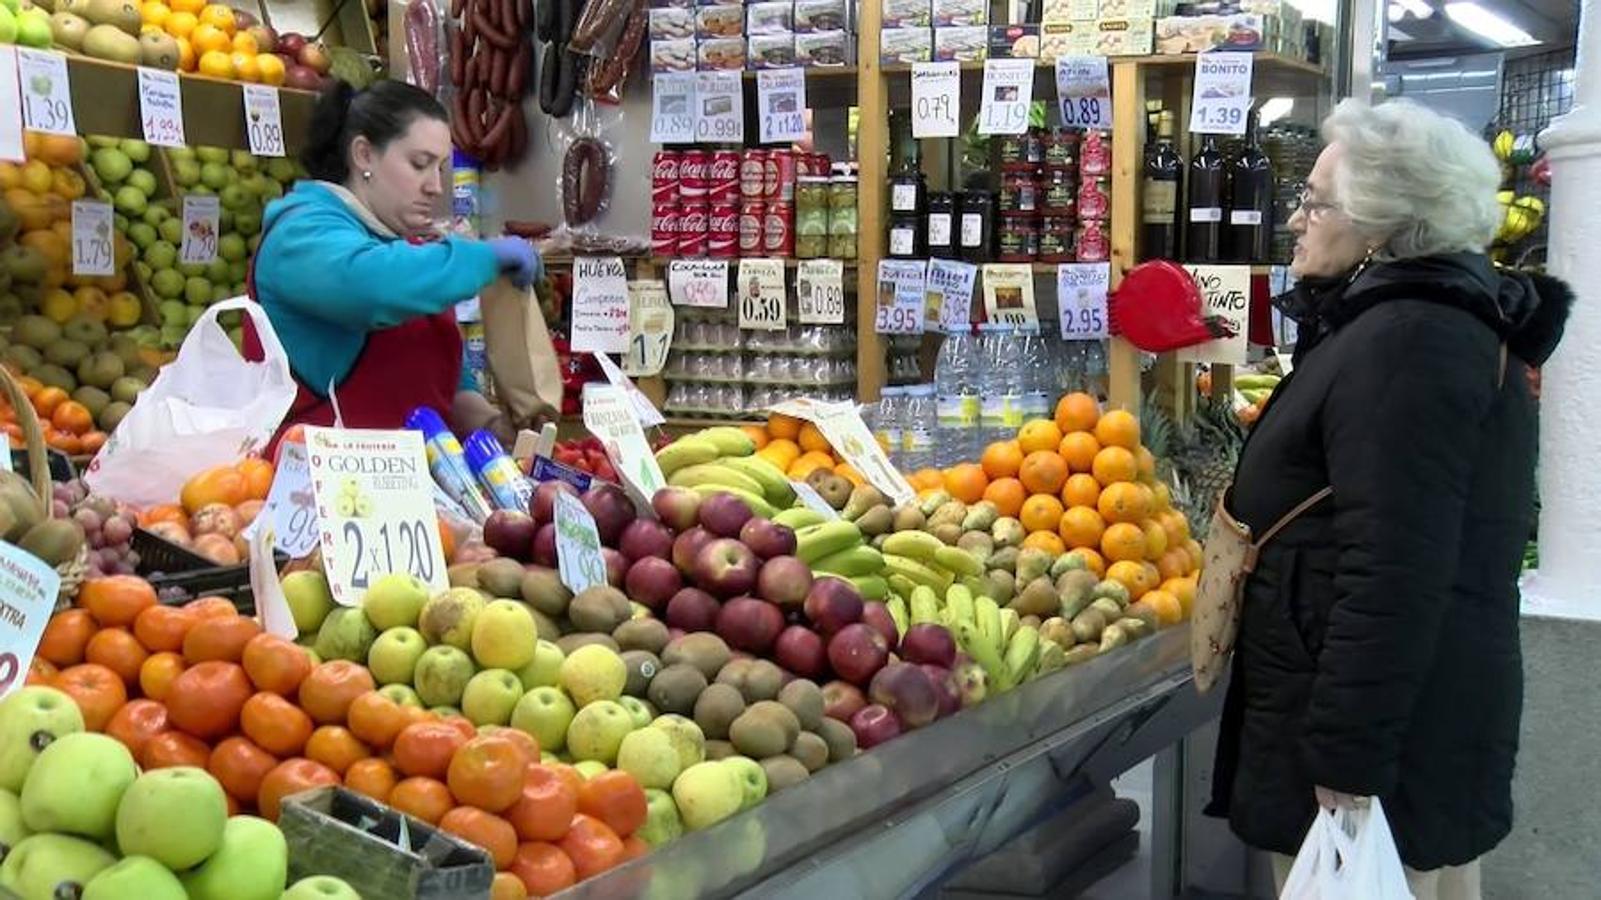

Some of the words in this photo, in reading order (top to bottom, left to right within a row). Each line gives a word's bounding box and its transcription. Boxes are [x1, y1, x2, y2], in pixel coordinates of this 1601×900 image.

[1201, 64, 1248, 74] BONITO
[25, 94, 69, 131] 1.39
[986, 103, 1027, 130] 1.19
[1063, 97, 1100, 125] 0.89
[1197, 106, 1243, 125] 1.39
[251, 123, 282, 153] 0.89
[76, 239, 113, 269] 1.79
[743, 296, 781, 322] 0.59
[815, 285, 842, 315] 0.89
[1205, 290, 1246, 311] TINTO
[1063, 308, 1103, 333] 2.95
[328, 455, 417, 474] GOLDEN
